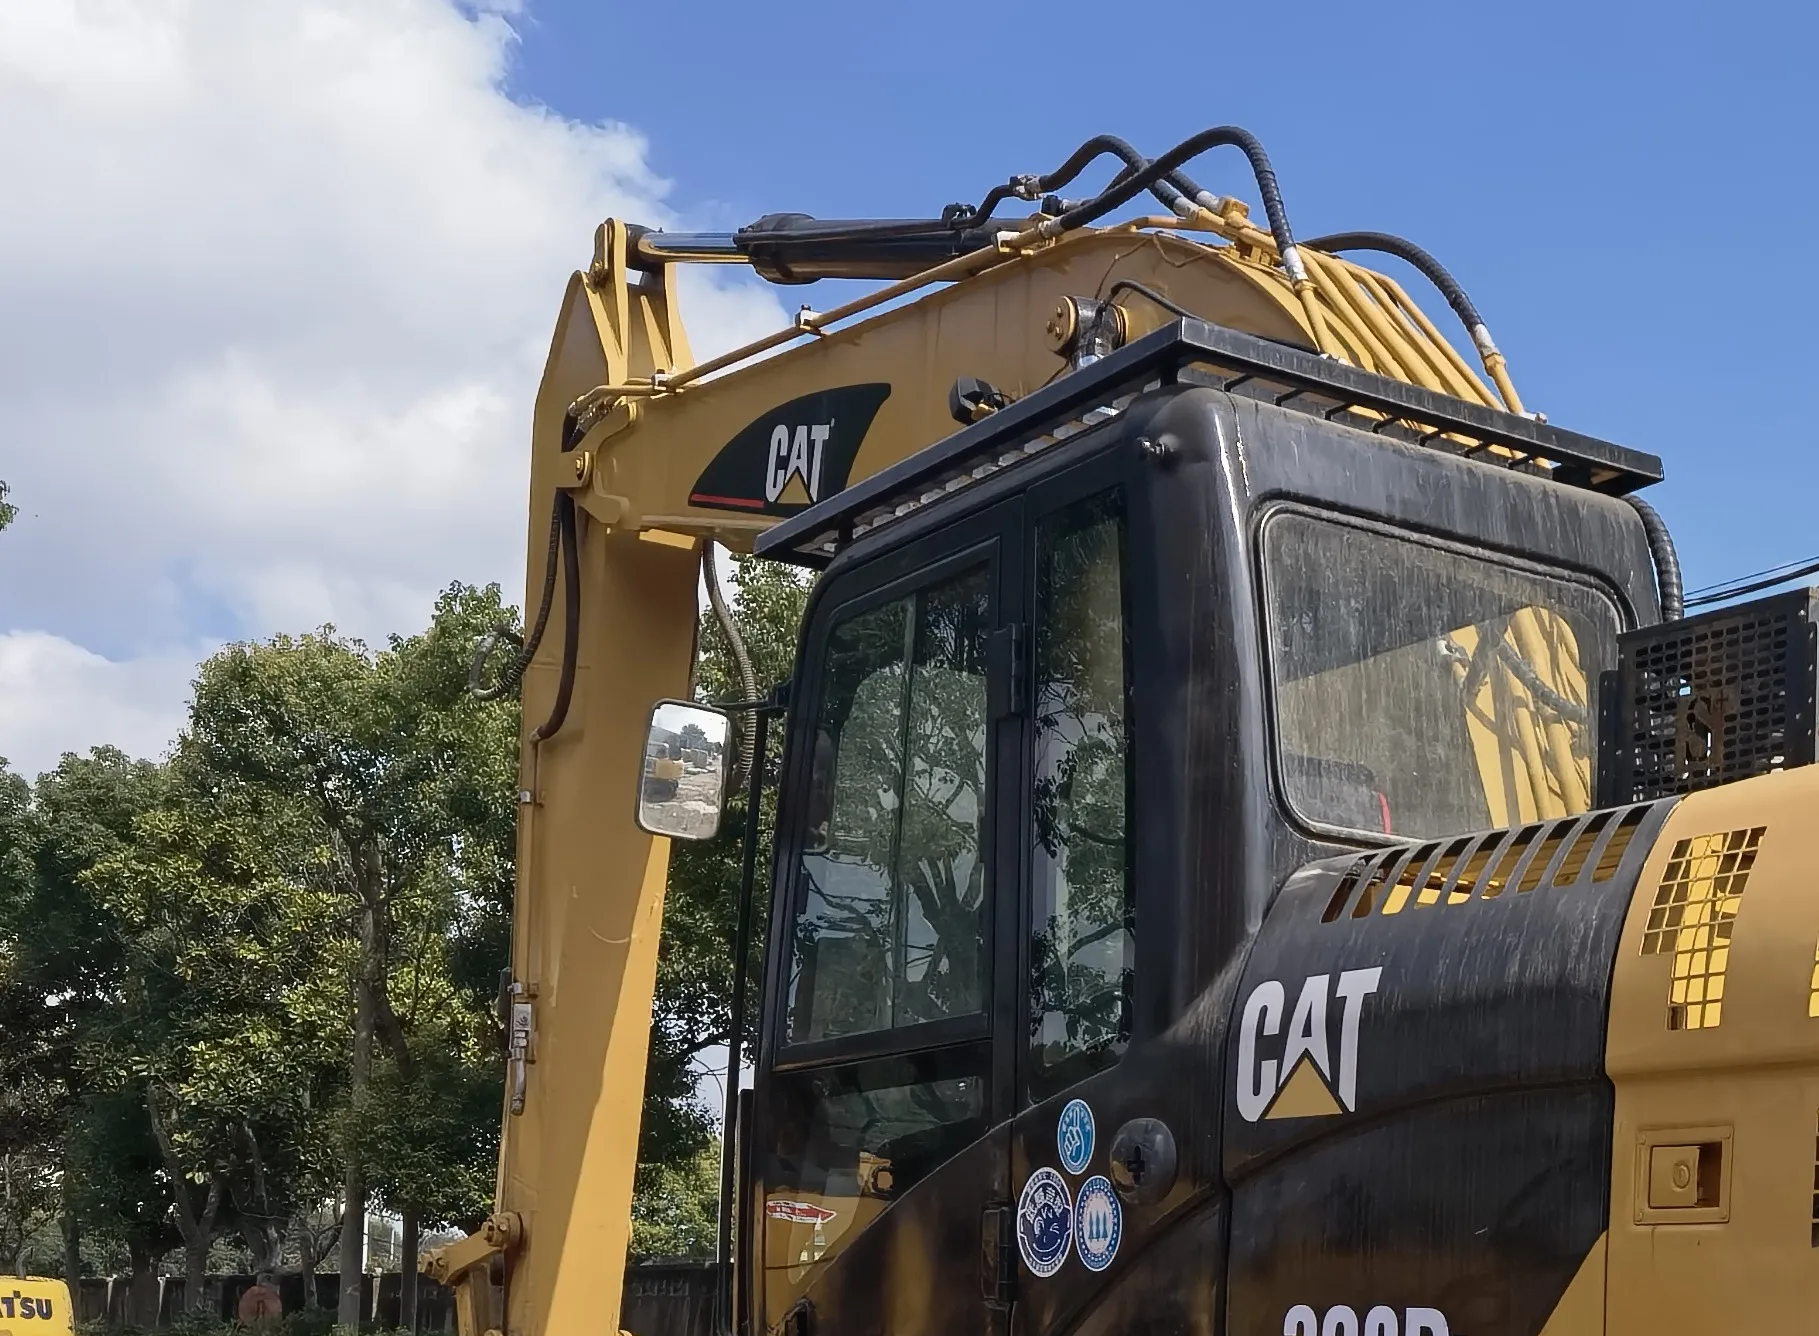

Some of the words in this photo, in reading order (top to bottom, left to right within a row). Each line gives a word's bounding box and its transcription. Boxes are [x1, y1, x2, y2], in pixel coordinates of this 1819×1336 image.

[765, 424, 831, 502] CAT
[1236, 967, 1383, 1122] CAT
[0, 1290, 53, 1320] TSU
